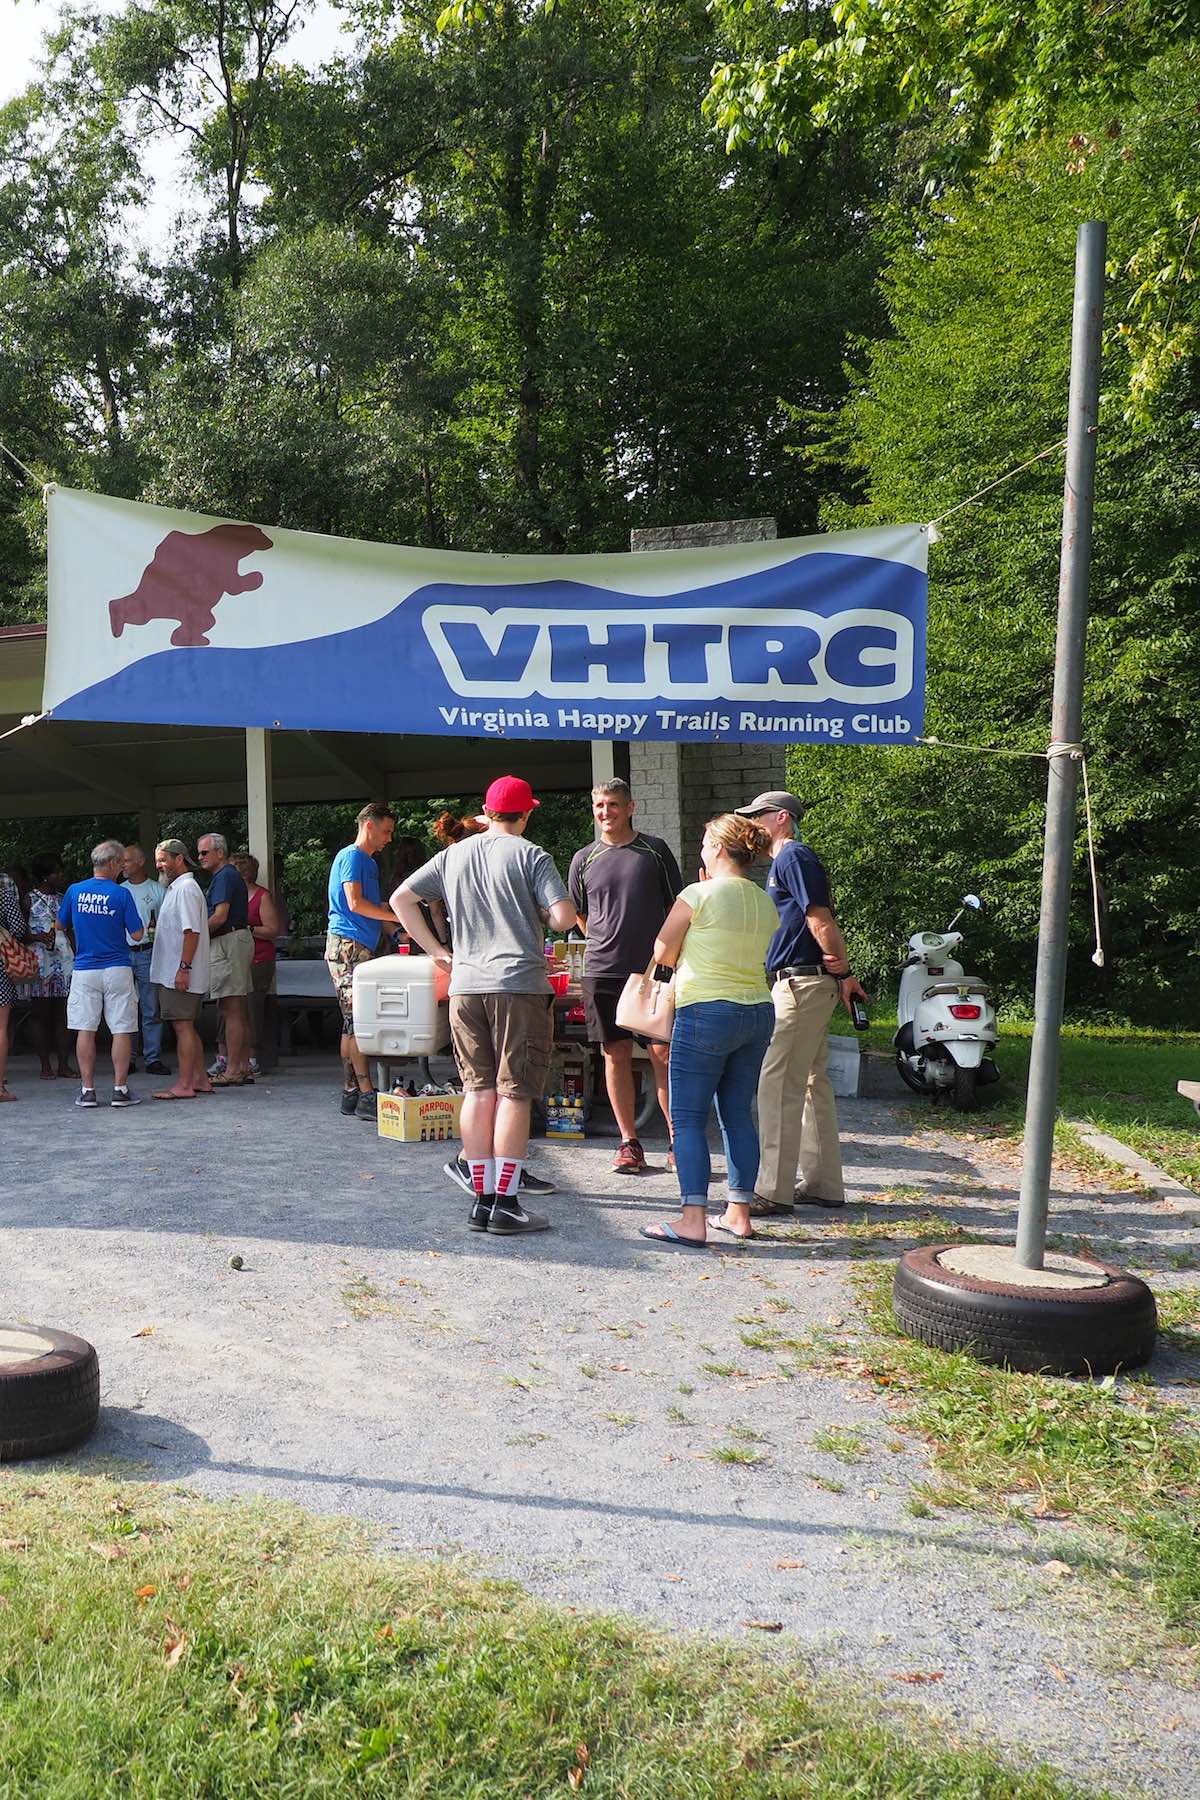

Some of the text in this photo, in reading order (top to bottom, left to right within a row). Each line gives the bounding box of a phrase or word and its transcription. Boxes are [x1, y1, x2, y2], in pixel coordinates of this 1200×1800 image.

[437, 620, 900, 690] VHTRC
[438, 706, 911, 738] Virginia Happy Trails Running Club
[78, 892, 110, 905] HAPPY
[77, 903, 109, 915] TRAILS
[419, 1101, 455, 1117] HARPOON
